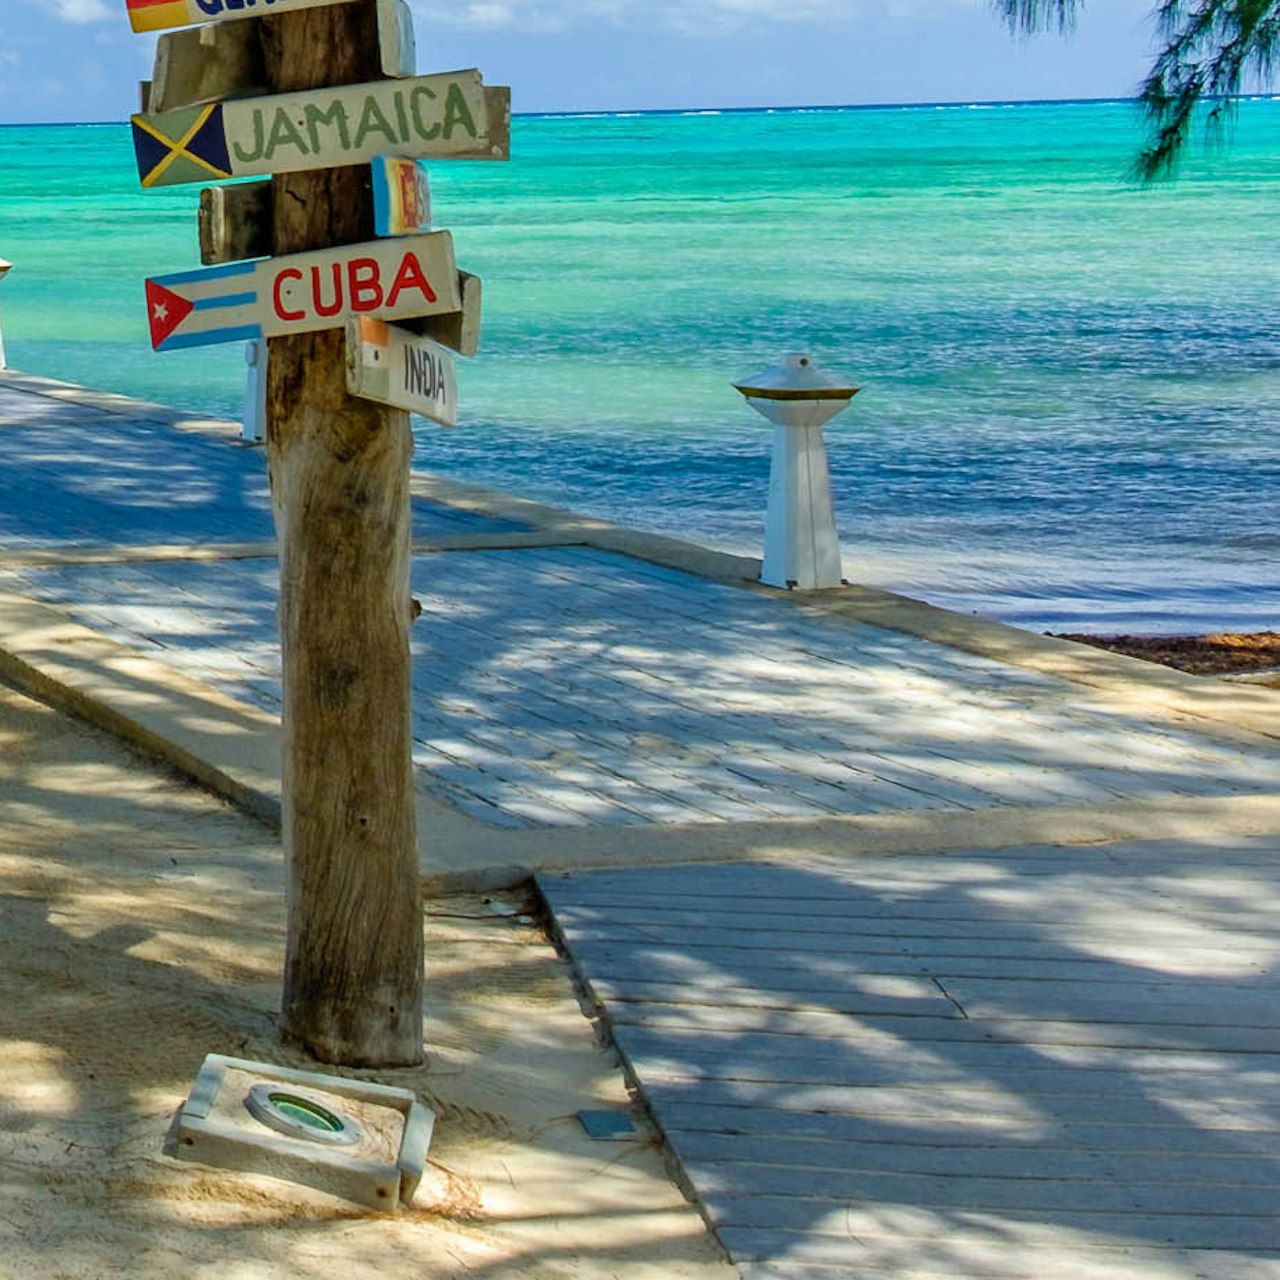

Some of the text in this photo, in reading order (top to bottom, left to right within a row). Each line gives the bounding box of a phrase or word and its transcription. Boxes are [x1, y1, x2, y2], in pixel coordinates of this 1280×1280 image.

[232, 83, 477, 162] JAMAICA
[273, 251, 436, 320] CUBA
[404, 343, 446, 406] INDIA
